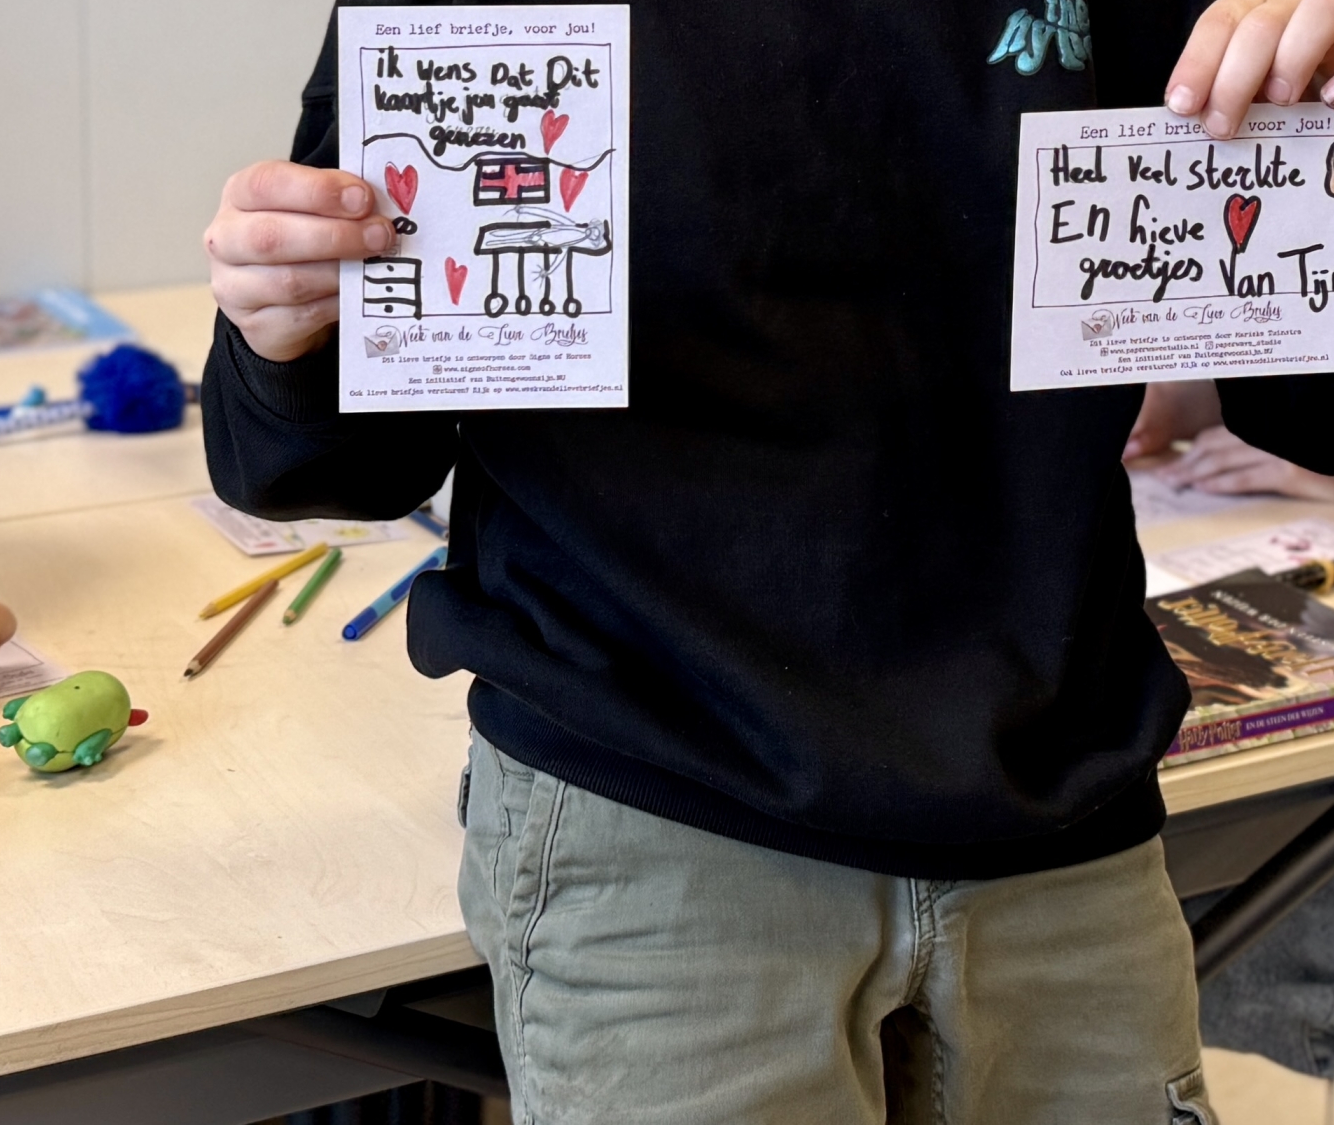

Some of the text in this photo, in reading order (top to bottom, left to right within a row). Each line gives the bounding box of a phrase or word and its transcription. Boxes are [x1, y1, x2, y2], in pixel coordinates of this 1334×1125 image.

[375, 22, 596, 36] Een lief briefje, voor jou!
[491, 62, 535, 91] Dat
[547, 55, 600, 92] Dit
[374, 81, 460, 123] kaartje
[1079, 117, 1331, 140] Een lief brie voor jou!
[428, 125, 526, 157] genezen
[1186, 143, 1306, 191] sterkte
[1049, 199, 1111, 244] En
[1079, 243, 1204, 304] groetjes
[1219, 243, 1276, 299] Van
[1142, 313, 1161, 323] van
[1166, 307, 1178, 321] de
[432, 331, 453, 343] van
[458, 325, 473, 342] de
[1130, 336, 1158, 346] briefje
[1215, 332, 1232, 340] door
[382, 356, 395, 364] Dit
[398, 355, 420, 363] lieve
[422, 355, 452, 364] briefje
[554, 352, 564, 360] of
[425, 376, 466, 384] initiatief
[367, 388, 387, 396] lieve
[391, 388, 424, 397] briefjes
[1178, 719, 1242, 753] Harry Potter
